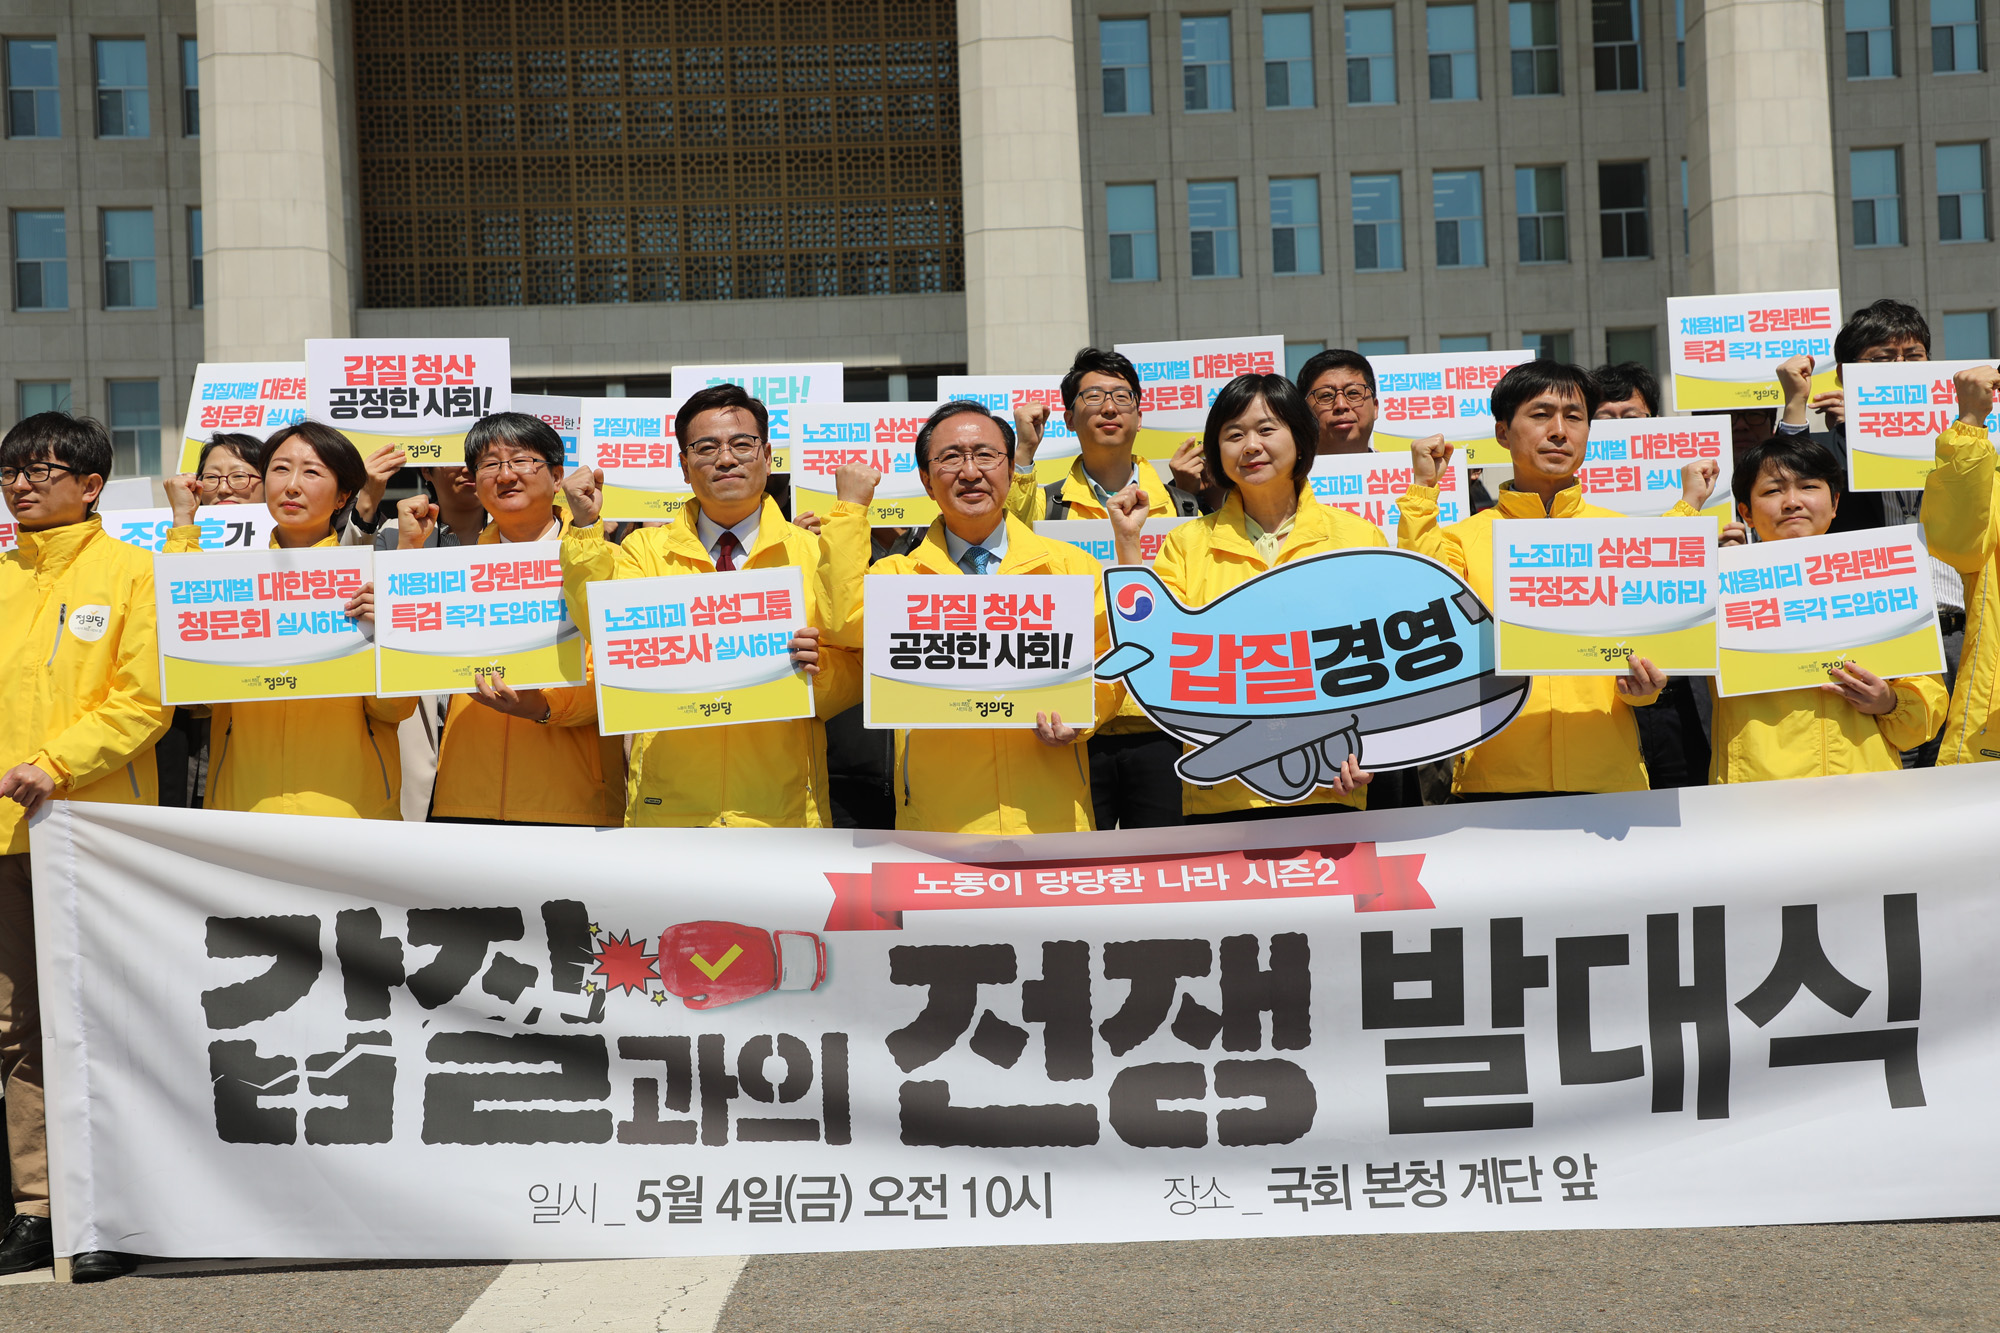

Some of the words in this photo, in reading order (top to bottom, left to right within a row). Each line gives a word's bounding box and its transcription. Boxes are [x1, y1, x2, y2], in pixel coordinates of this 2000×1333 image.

[1681, 315, 1744, 335] 채용비리
[1748, 307, 1831, 333] 강원랜드
[1684, 339, 1726, 363] 특검
[1729, 341, 1762, 360] 즉각
[1765, 338, 1831, 359] 도입하라
[344, 355, 407, 386] 갑질
[411, 354, 476, 386] 청산
[1193, 351, 1275, 379] 대한항공
[1378, 371, 1442, 392] 갑질재벌
[1445, 365, 1521, 390] 대한항
[201, 382, 259, 400] 갑질재벌
[329, 387, 419, 419] 공정한
[423, 386, 493, 418] 사회!
[1753, 389, 1780, 400] 정의당
[1858, 384, 1927, 406] 노조파괴
[200, 405, 265, 428] 청문회
[1384, 395, 1455, 421] 청문회
[593, 417, 661, 437] 갑질재벌
[803, 422, 870, 443] 노조파괴
[1859, 410, 1949, 438] 국정조사
[407, 444, 442, 458] 정의당
[597, 442, 672, 468] 청문회
[1630, 431, 1720, 460] 대한항공
[1366, 465, 1457, 495] 삼성룹
[877, 508, 905, 519] 정의당
[1509, 543, 1593, 568] 노조파괴
[1598, 536, 1706, 568] 삼성그룹
[388, 569, 466, 596] 채용비리
[470, 559, 564, 593] 강원랜드
[1718, 563, 1803, 595] 채용비리
[1805, 544, 1917, 586] 강원랜드
[170, 578, 253, 605] 갑질재벌
[257, 568, 362, 602] 대한항공
[1509, 575, 1618, 607] 국정조사
[1621, 579, 1707, 605] 실시하라
[76, 614, 105, 627] 정의당
[392, 601, 442, 632] 특검
[446, 604, 486, 628] 즉각
[490, 598, 568, 626] 도입하라
[605, 603, 686, 633] 노조파괴
[690, 589, 792, 627] 삼성그룹
[907, 594, 977, 631] 갑질
[983, 593, 1056, 631] 청산
[1725, 597, 1781, 631] 특검
[1784, 597, 1828, 623] 즉각
[1831, 586, 1918, 619] 도입하라
[177, 608, 271, 642] 청문회
[607, 633, 713, 670] 국정조사
[715, 631, 794, 661] 실시하라
[889, 632, 991, 670] 공정한
[994, 632, 1073, 670] 사회!
[1600, 648, 1634, 662] 정의당
[1821, 659, 1856, 675] 정의
[264, 676, 297, 690] 정의당
[699, 702, 732, 717] 정의당
[976, 702, 1015, 717] 정의당
[912, 872, 1023, 898] 노동이
[1036, 868, 1146, 895] 당당한
[1158, 863, 1230, 891] 나라
[1241, 858, 1340, 887] 시즌2
[885, 932, 1318, 1149] 전쟁
[1360, 892, 1927, 1135] 발대식
[1266, 1163, 1353, 1212] 국회
[1362, 1159, 1448, 1210] 본청
[1460, 1155, 1544, 1206] 계단
[1552, 1152, 1599, 1202] 앞
[636, 1174, 703, 1225] 5월
[715, 1173, 853, 1225] 4일(금)
[863, 1173, 949, 1221] 오전
[962, 1171, 1054, 1220] 10시
